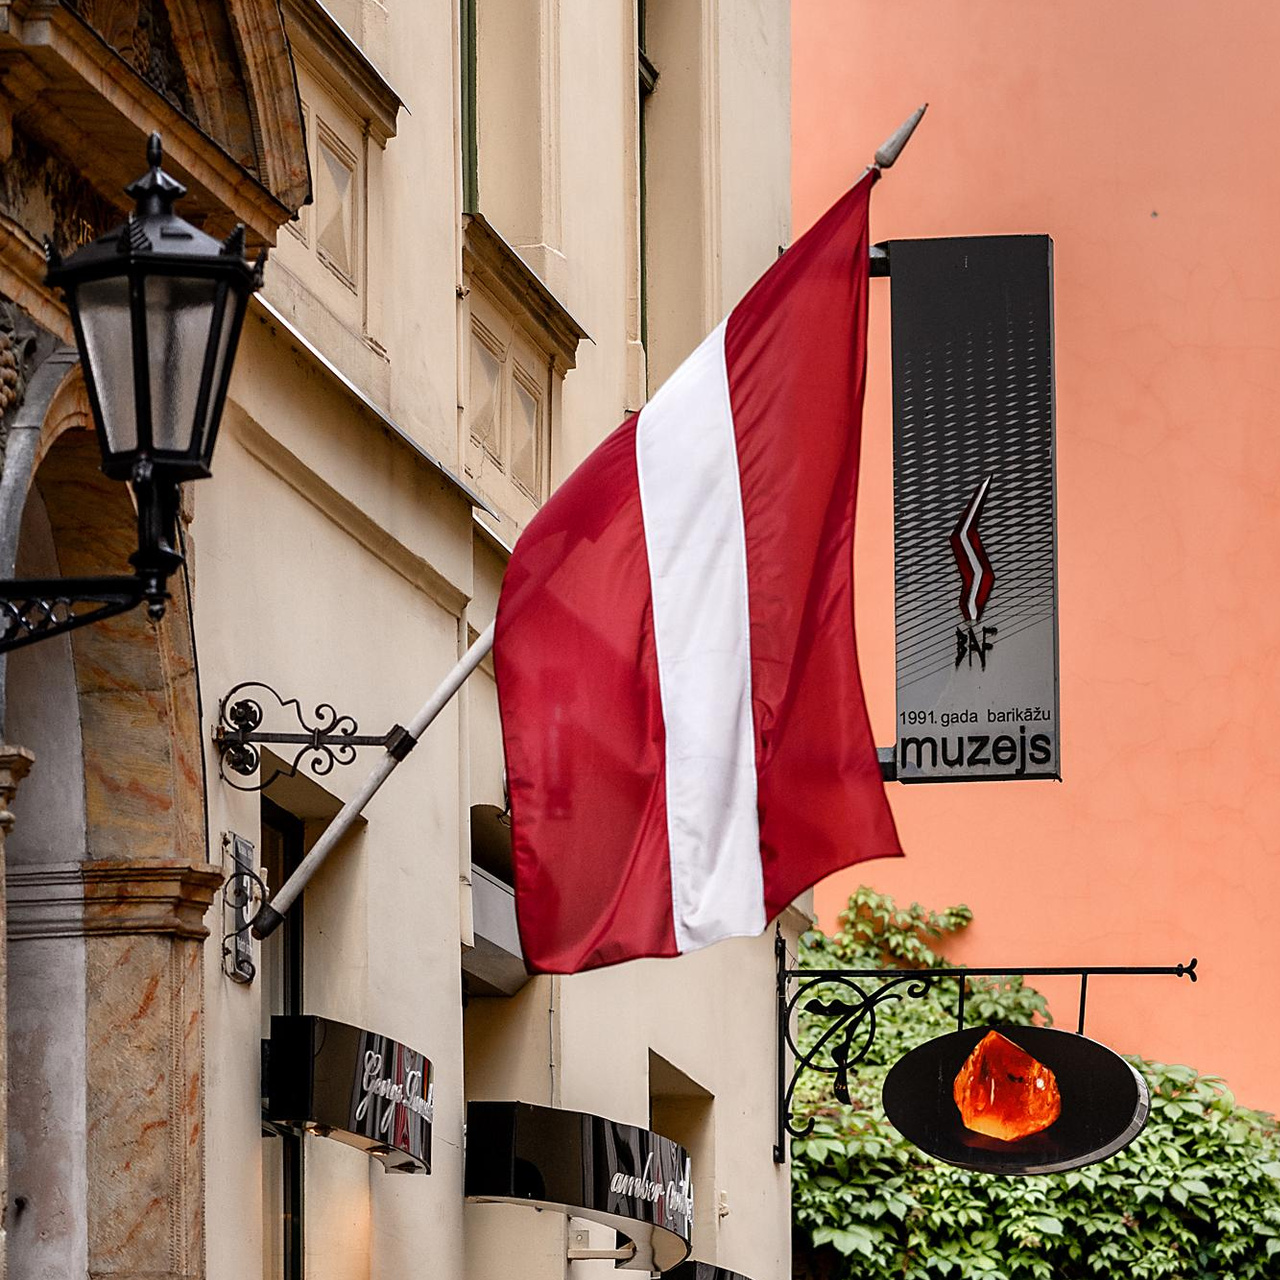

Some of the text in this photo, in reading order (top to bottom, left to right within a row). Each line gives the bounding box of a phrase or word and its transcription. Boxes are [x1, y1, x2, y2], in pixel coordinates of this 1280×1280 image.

[900, 707, 1051, 727] 1991. gada barikāžu
[901, 725, 1051, 775] muzejs
[610, 1151, 666, 1203] amber
